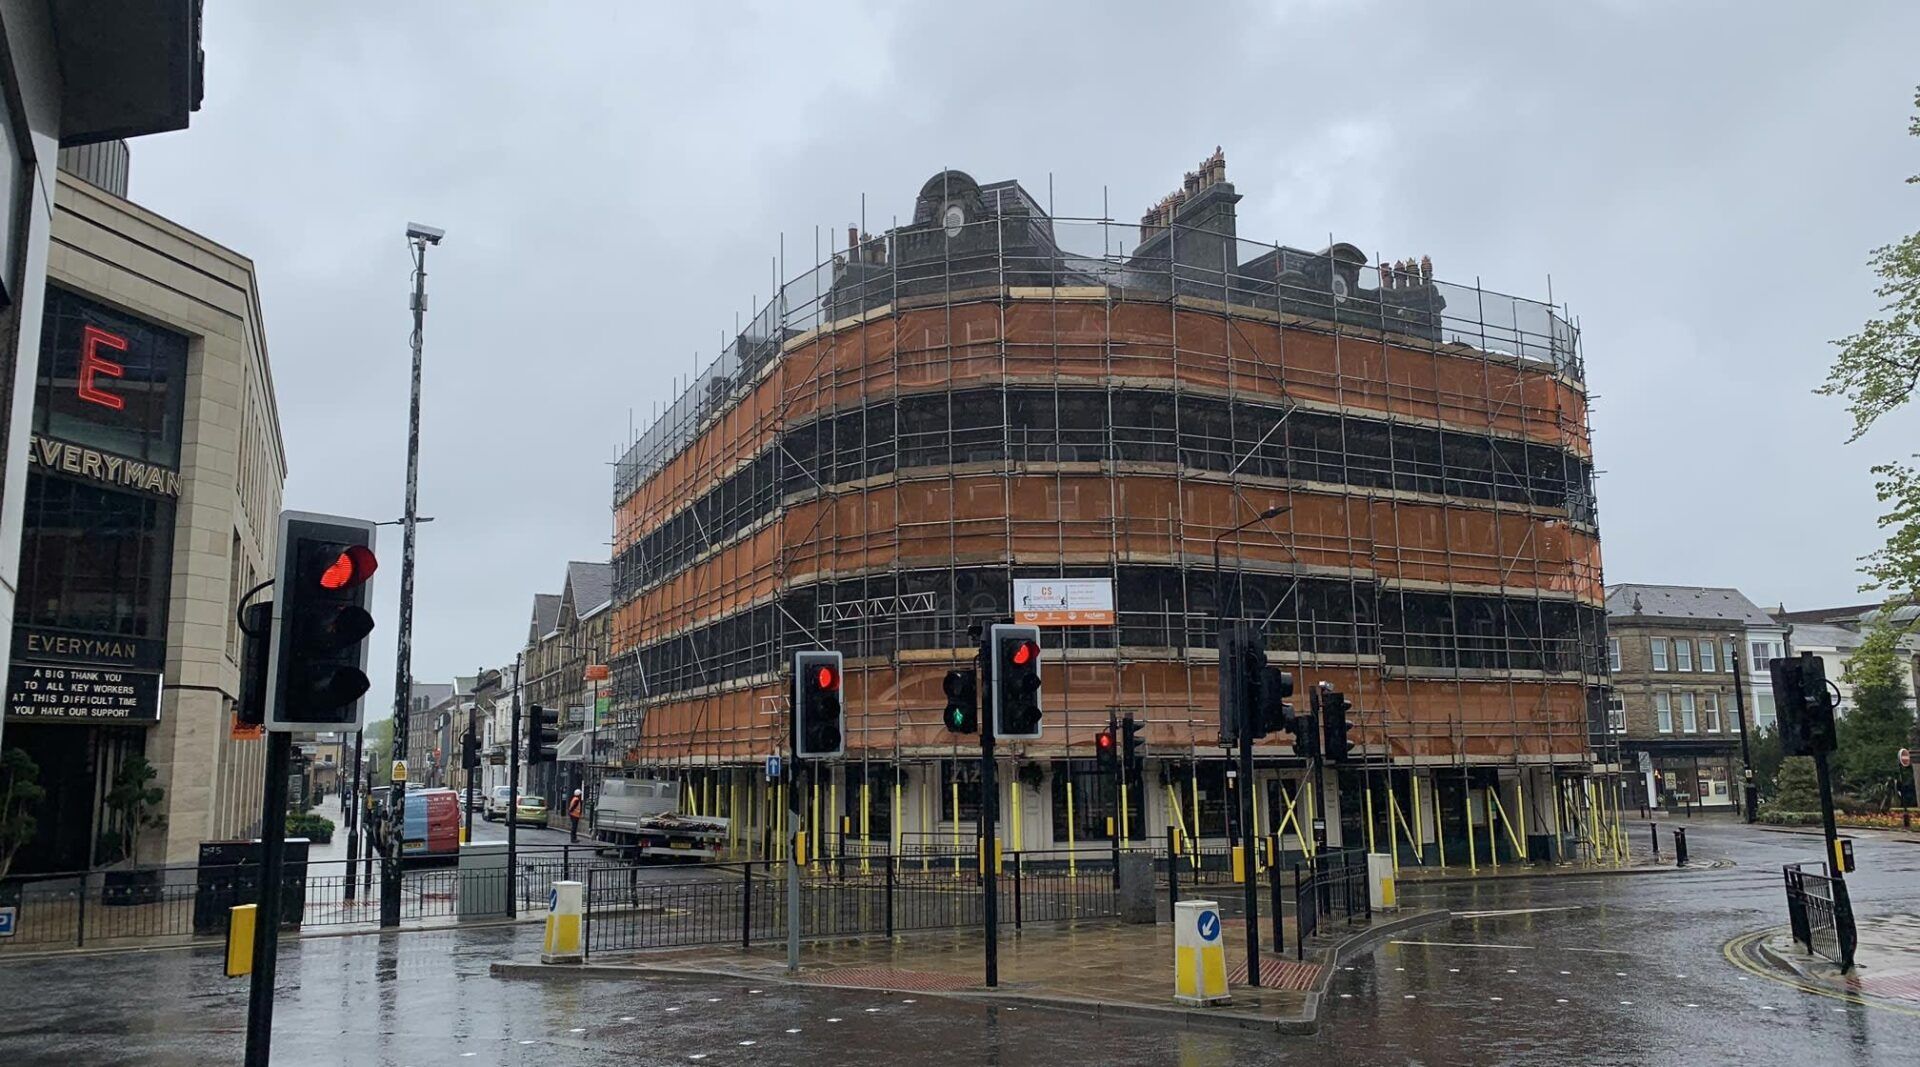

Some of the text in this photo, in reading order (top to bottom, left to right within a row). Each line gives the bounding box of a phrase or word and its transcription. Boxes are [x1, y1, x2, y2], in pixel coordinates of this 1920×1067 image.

[76, 324, 127, 411] E
[28, 634, 137, 659] EVERYMAN
[34, 669, 122, 682] A BIG THANK YOU
[24, 680, 134, 695] TO ALL KEY WORKERS
[12, 693, 137, 706] AT THIS DIFFICULT TIME
[14, 705, 130, 718] YOU HAVE OUR SUPPORT
